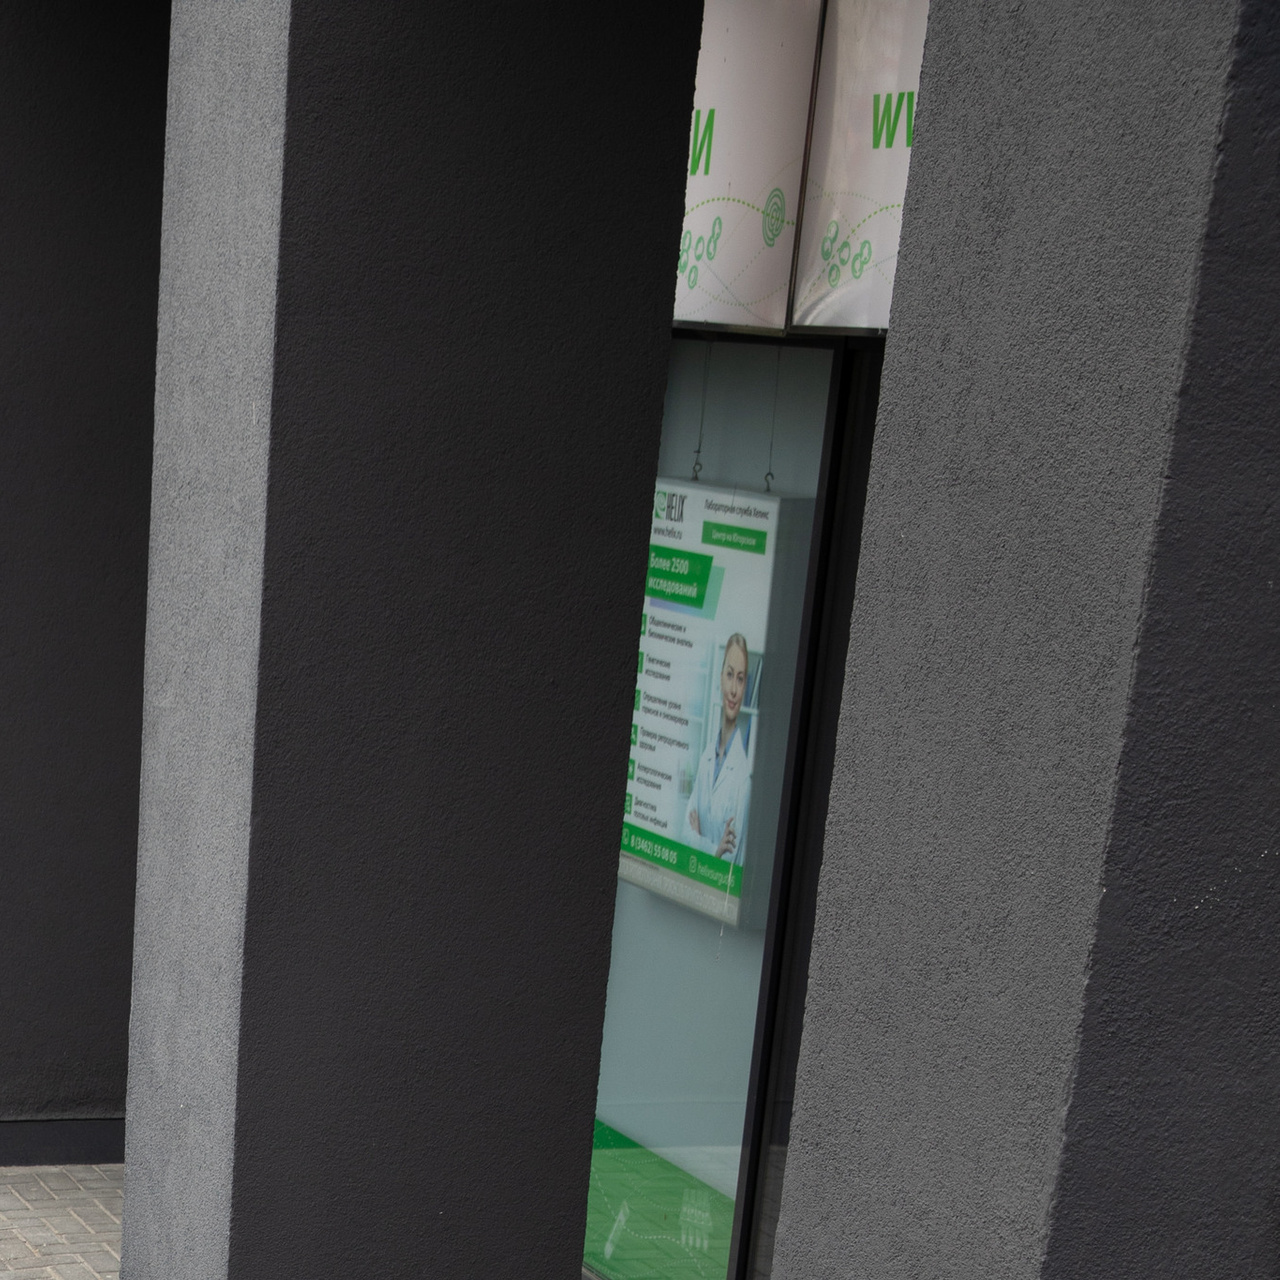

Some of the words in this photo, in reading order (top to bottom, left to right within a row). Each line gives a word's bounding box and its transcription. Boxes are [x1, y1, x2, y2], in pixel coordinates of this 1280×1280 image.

[665, 493, 687, 523] HELIX
[650, 553, 672, 573] Более
[671, 558, 689, 575] 2500
[648, 578, 699, 598] исследований
[635, 835, 653, 856] (3462)
